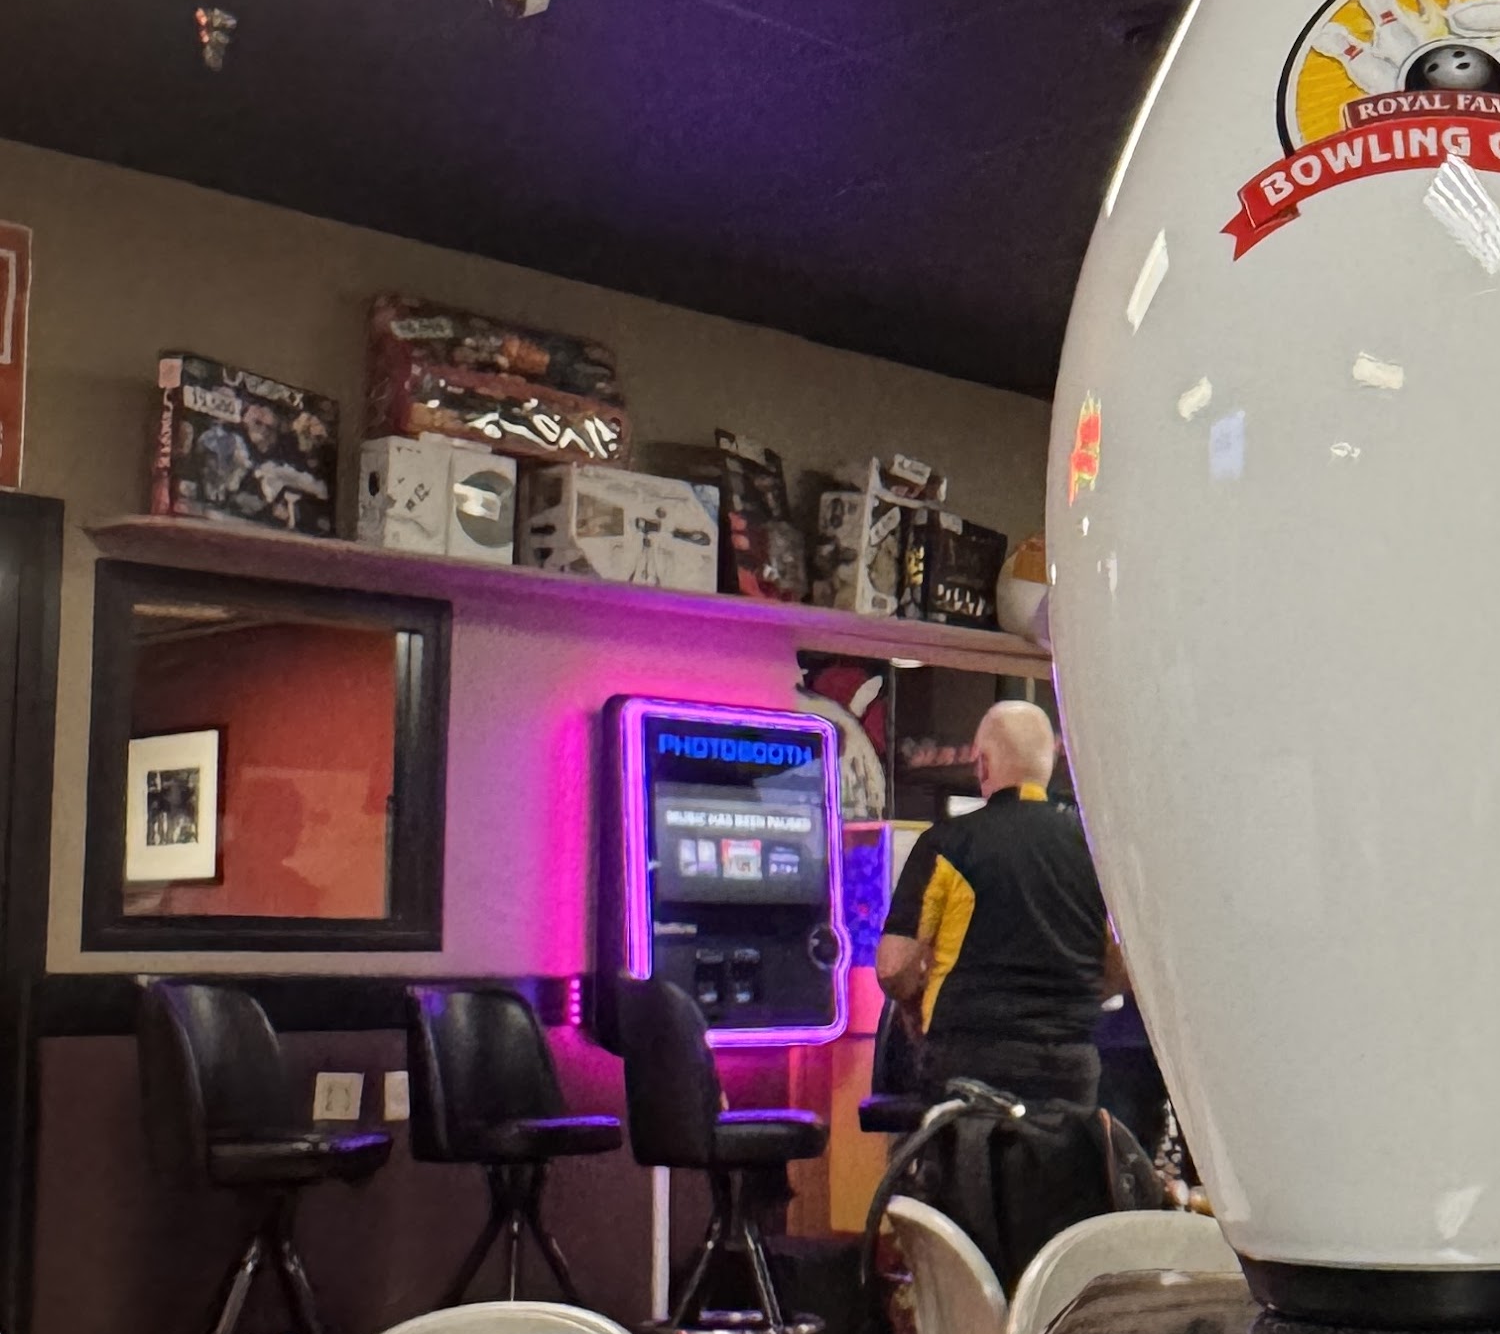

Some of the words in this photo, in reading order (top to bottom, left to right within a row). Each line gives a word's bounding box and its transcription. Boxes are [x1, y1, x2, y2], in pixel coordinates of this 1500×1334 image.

[1357, 93, 1450, 120] ROYAL
[1259, 125, 1472, 207] BOWLING
[658, 733, 813, 767] PHOTOBOOTH
